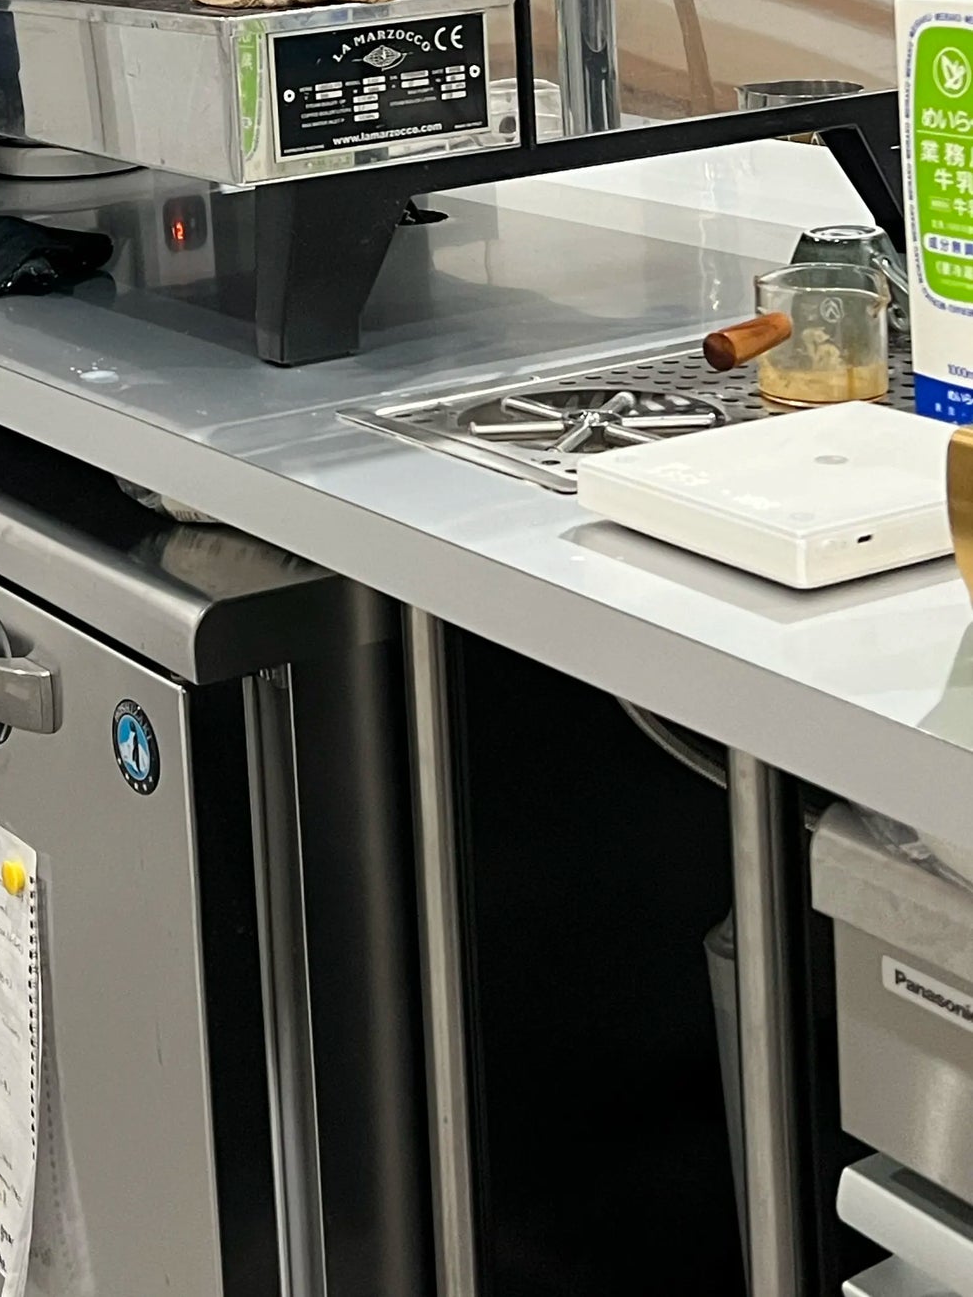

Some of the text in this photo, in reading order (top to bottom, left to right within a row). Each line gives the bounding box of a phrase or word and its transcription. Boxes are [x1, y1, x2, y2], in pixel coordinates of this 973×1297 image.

[332, 43, 352, 63] LA
[353, 29, 432, 52] MARZOCCO
[332, 122, 443, 146] www.lamarzocco.com
[922, 107, 973, 132] めいら
[894, 968, 973, 1022] Panasoni
